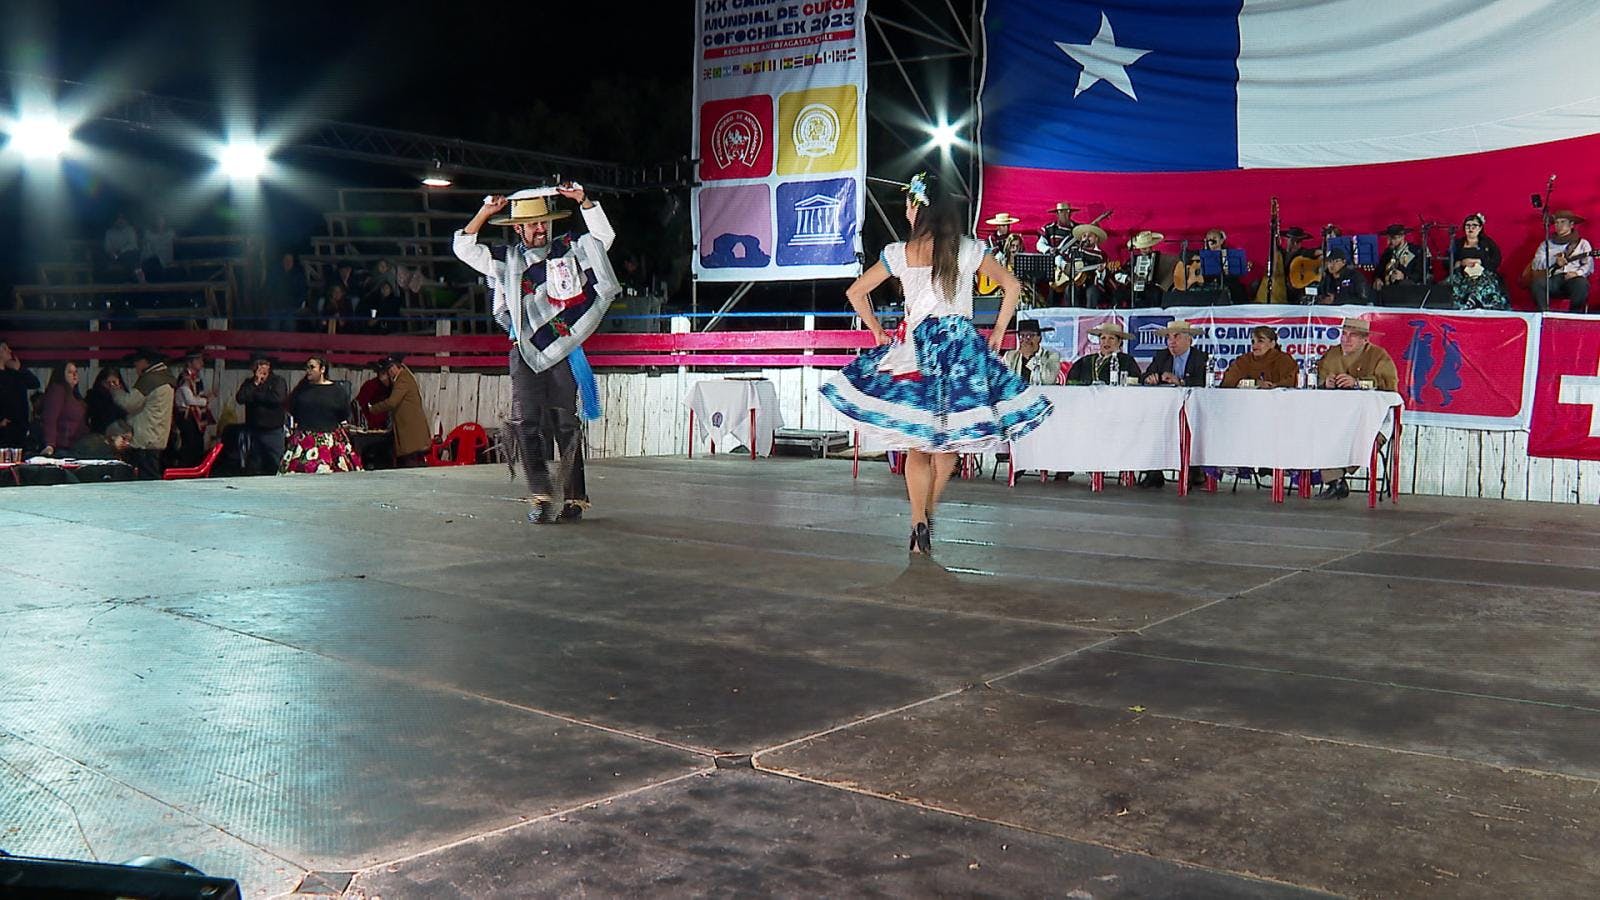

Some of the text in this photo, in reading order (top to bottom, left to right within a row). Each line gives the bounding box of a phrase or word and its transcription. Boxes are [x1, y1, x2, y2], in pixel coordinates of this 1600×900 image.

[705, 0, 727, 14] XX
[704, 10, 774, 31] MUNDIAL
[777, 5, 799, 20] DE
[703, 12, 855, 46] COFOCHILEX 2023
[1215, 326, 1340, 339] CAMONATO
[1286, 344, 1328, 355] CUEC
